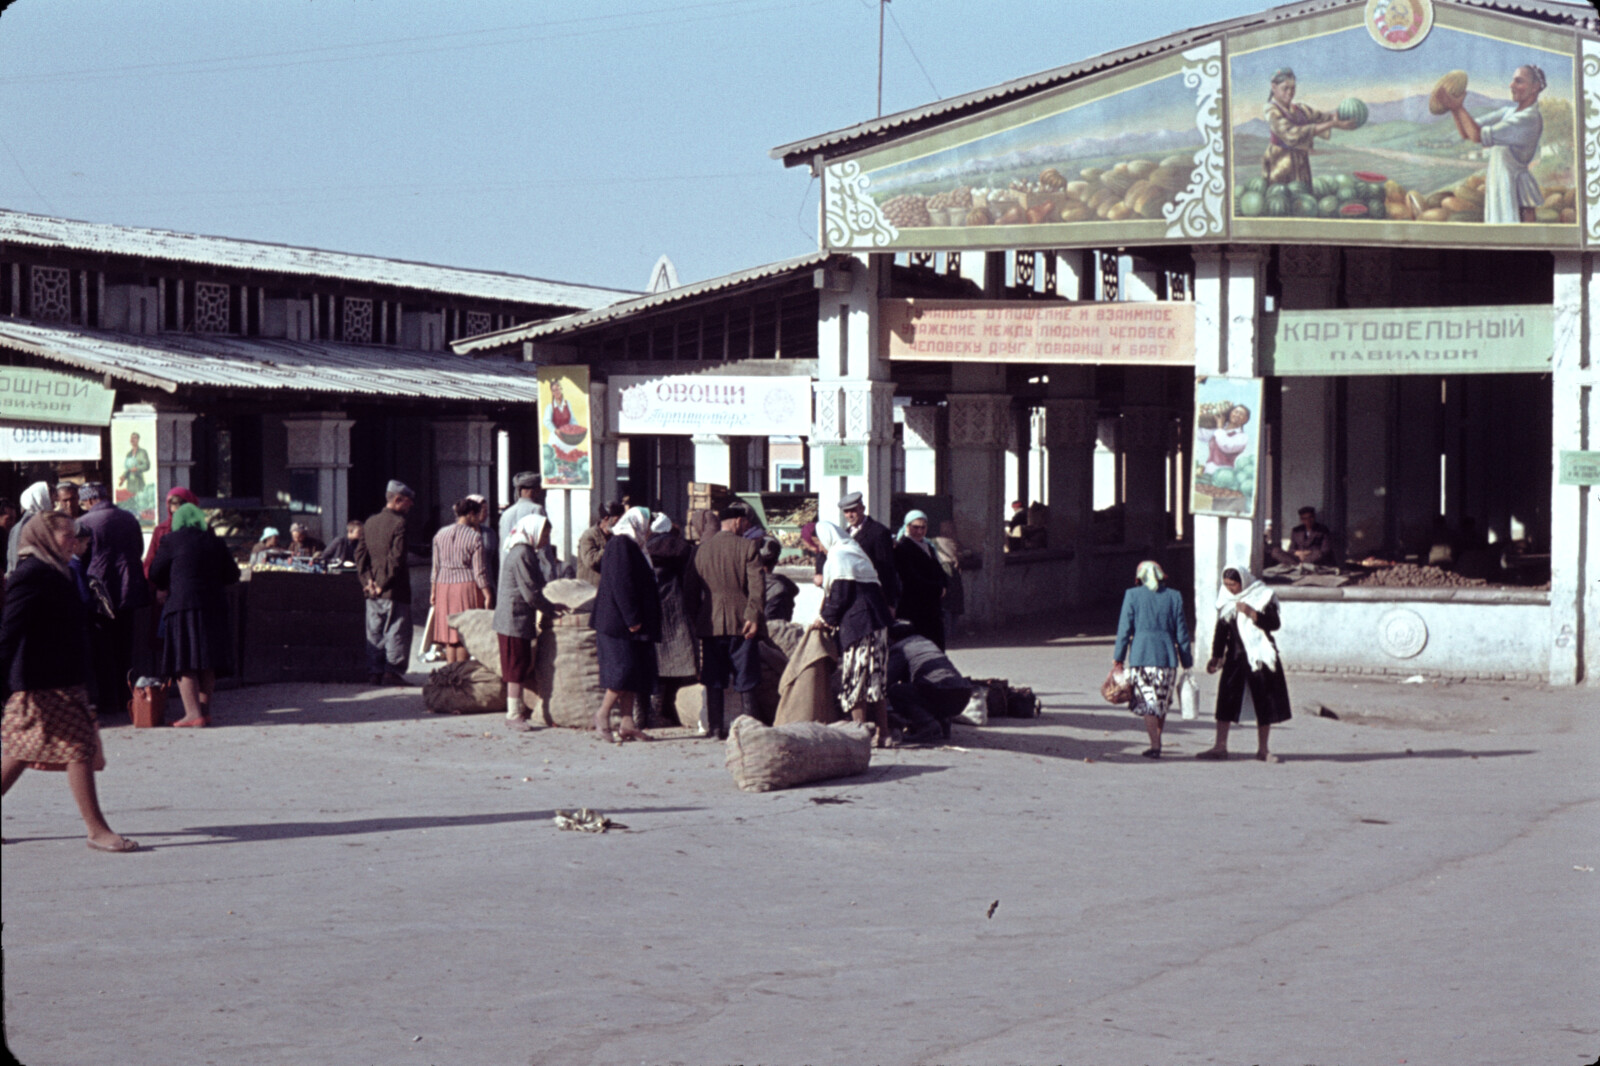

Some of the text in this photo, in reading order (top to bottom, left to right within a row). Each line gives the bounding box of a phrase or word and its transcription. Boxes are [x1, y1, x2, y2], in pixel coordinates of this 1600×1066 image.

[905, 305, 1173, 321] ГУМАННОЕ ОТНОШЕНИЕ И ВЗАИМНОЕ
[901, 323, 1176, 339] УВАЖЕНИЕ МЕЖДУ ЛЮДЬМИ ЧЕЛОВЕК
[1284, 313, 1524, 341] КАРТОФЕЛЬНЫЙ
[909, 341, 982, 353] ЧЕЛОВЕКУ
[1035, 342, 1104, 356] ТОВАРИЩ
[1112, 344, 1121, 355] И
[1130, 344, 1168, 356] БРАТ
[1330, 349, 1478, 361] ПАВИЛЬОН
[656, 383, 745, 405] ОВОЩИ
[13, 425, 82, 444] ОВОЩИ
